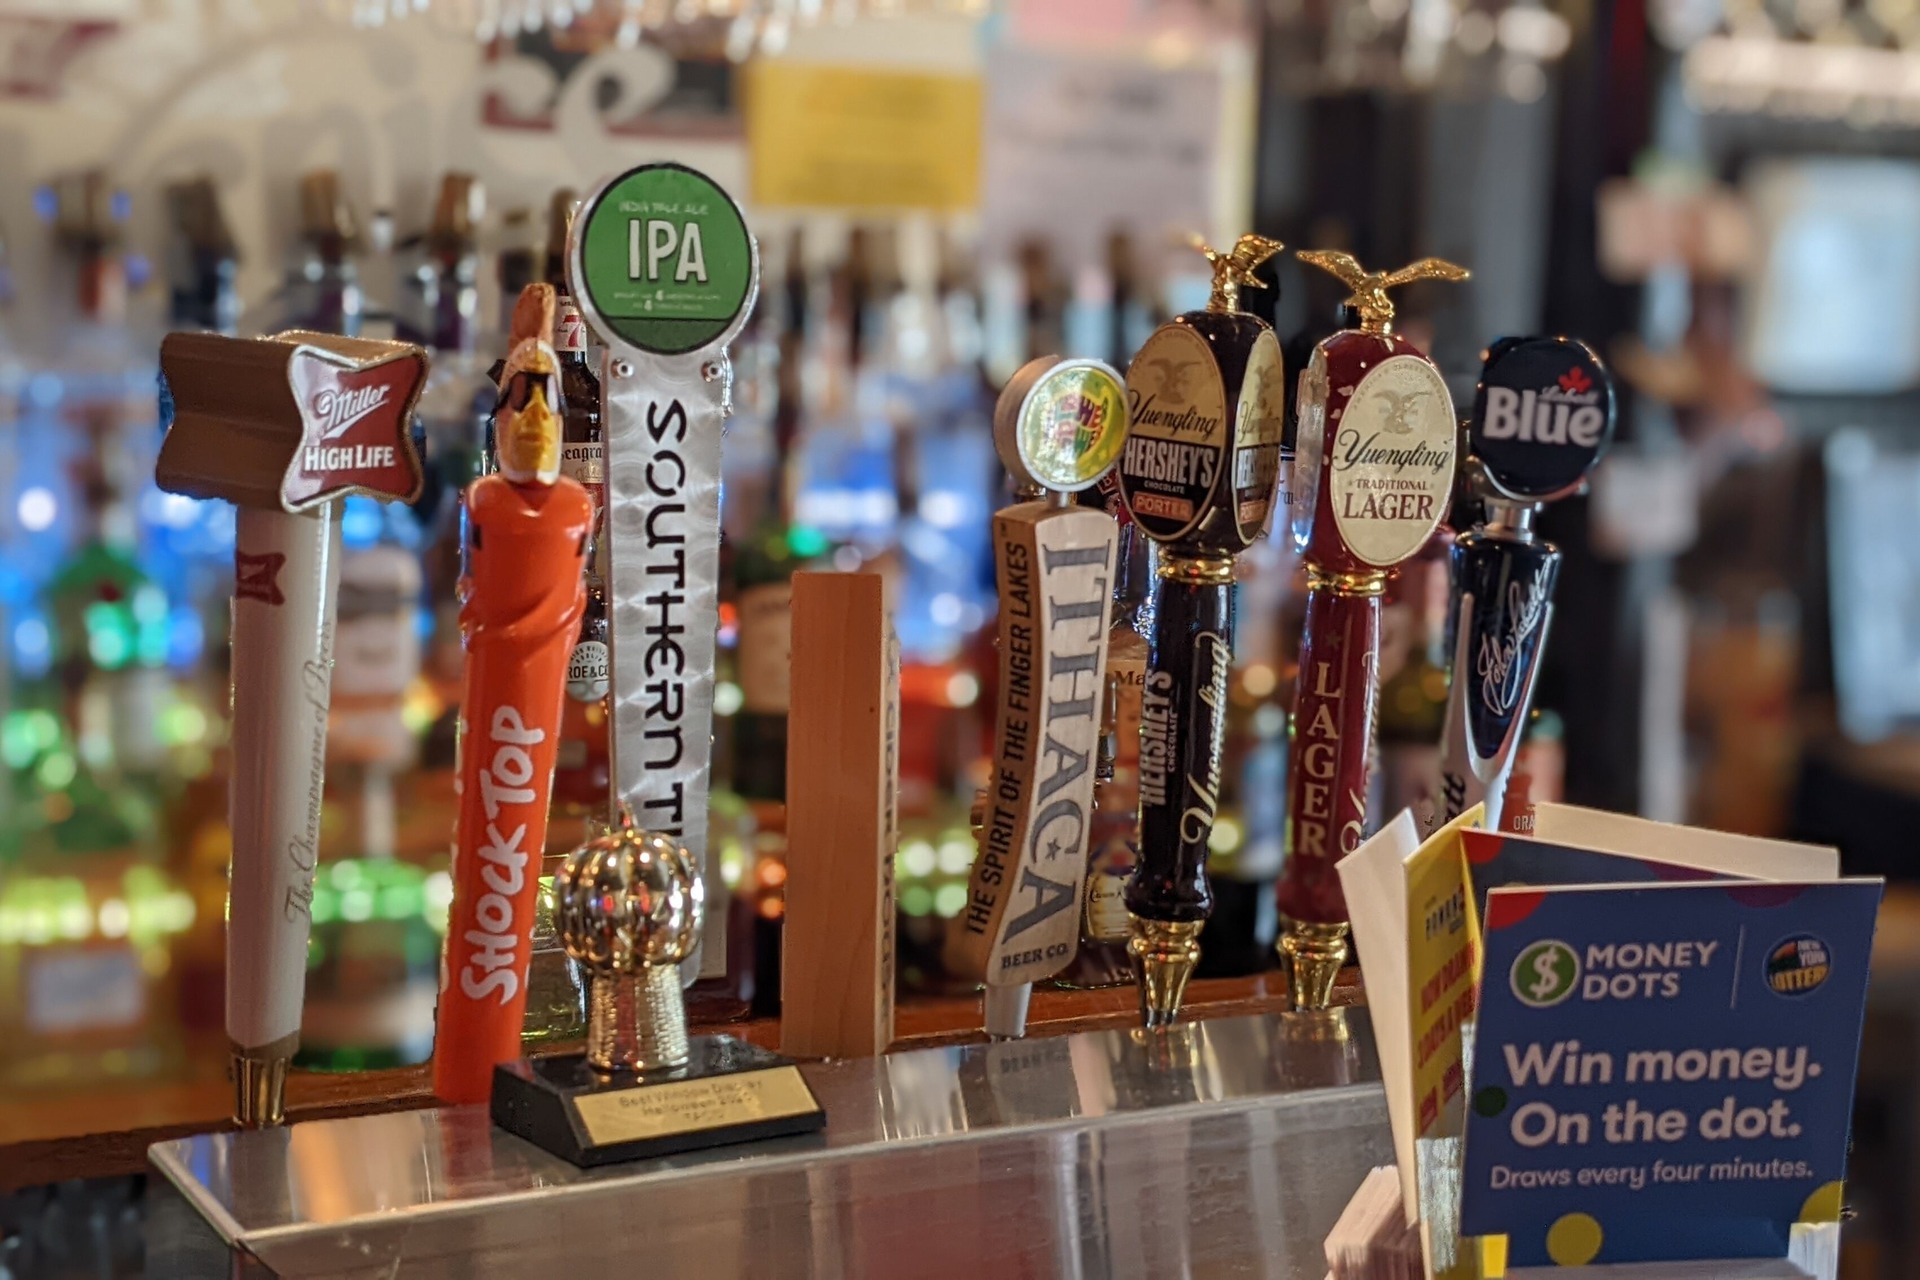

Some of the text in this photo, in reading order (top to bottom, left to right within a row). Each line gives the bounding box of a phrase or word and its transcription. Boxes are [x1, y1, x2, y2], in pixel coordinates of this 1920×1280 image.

[629, 219, 708, 281] IPA
[563, 314, 580, 347] 7
[316, 384, 391, 432] Miller
[1127, 389, 1219, 441] Yuengling
[1483, 387, 1604, 447] Blue
[304, 444, 395, 471] HIGH LIFE
[1123, 438, 1215, 488] HERSHEY'S
[1331, 429, 1451, 475] Yuengling
[1136, 497, 1192, 518] PORTER
[1143, 480, 1186, 494] CHOCOLATE
[1343, 493, 1434, 520] LAGER
[1355, 479, 1429, 491] TRADITIONAL
[645, 398, 687, 770] SOUTHERN
[1115, 671, 1146, 686] Ma
[968, 541, 1032, 934] THE SPIRIT OF THE FINGER LAKES
[1001, 538, 1112, 945] ITHACA
[1140, 670, 1172, 807] HERSHEY'S
[1301, 662, 1342, 858] LAGER
[287, 728, 324, 874] Champagne
[283, 885, 314, 925] The
[1001, 948, 1043, 969] BEER
[1585, 940, 1718, 970] MONEY
[1583, 973, 1680, 1000] DOTS
[1503, 1040, 1613, 1087] Win
[1625, 1047, 1823, 1091] money.
[1510, 1096, 1802, 1147] On the dot.
[1490, 1156, 1814, 1190] Draws every four minutes.
